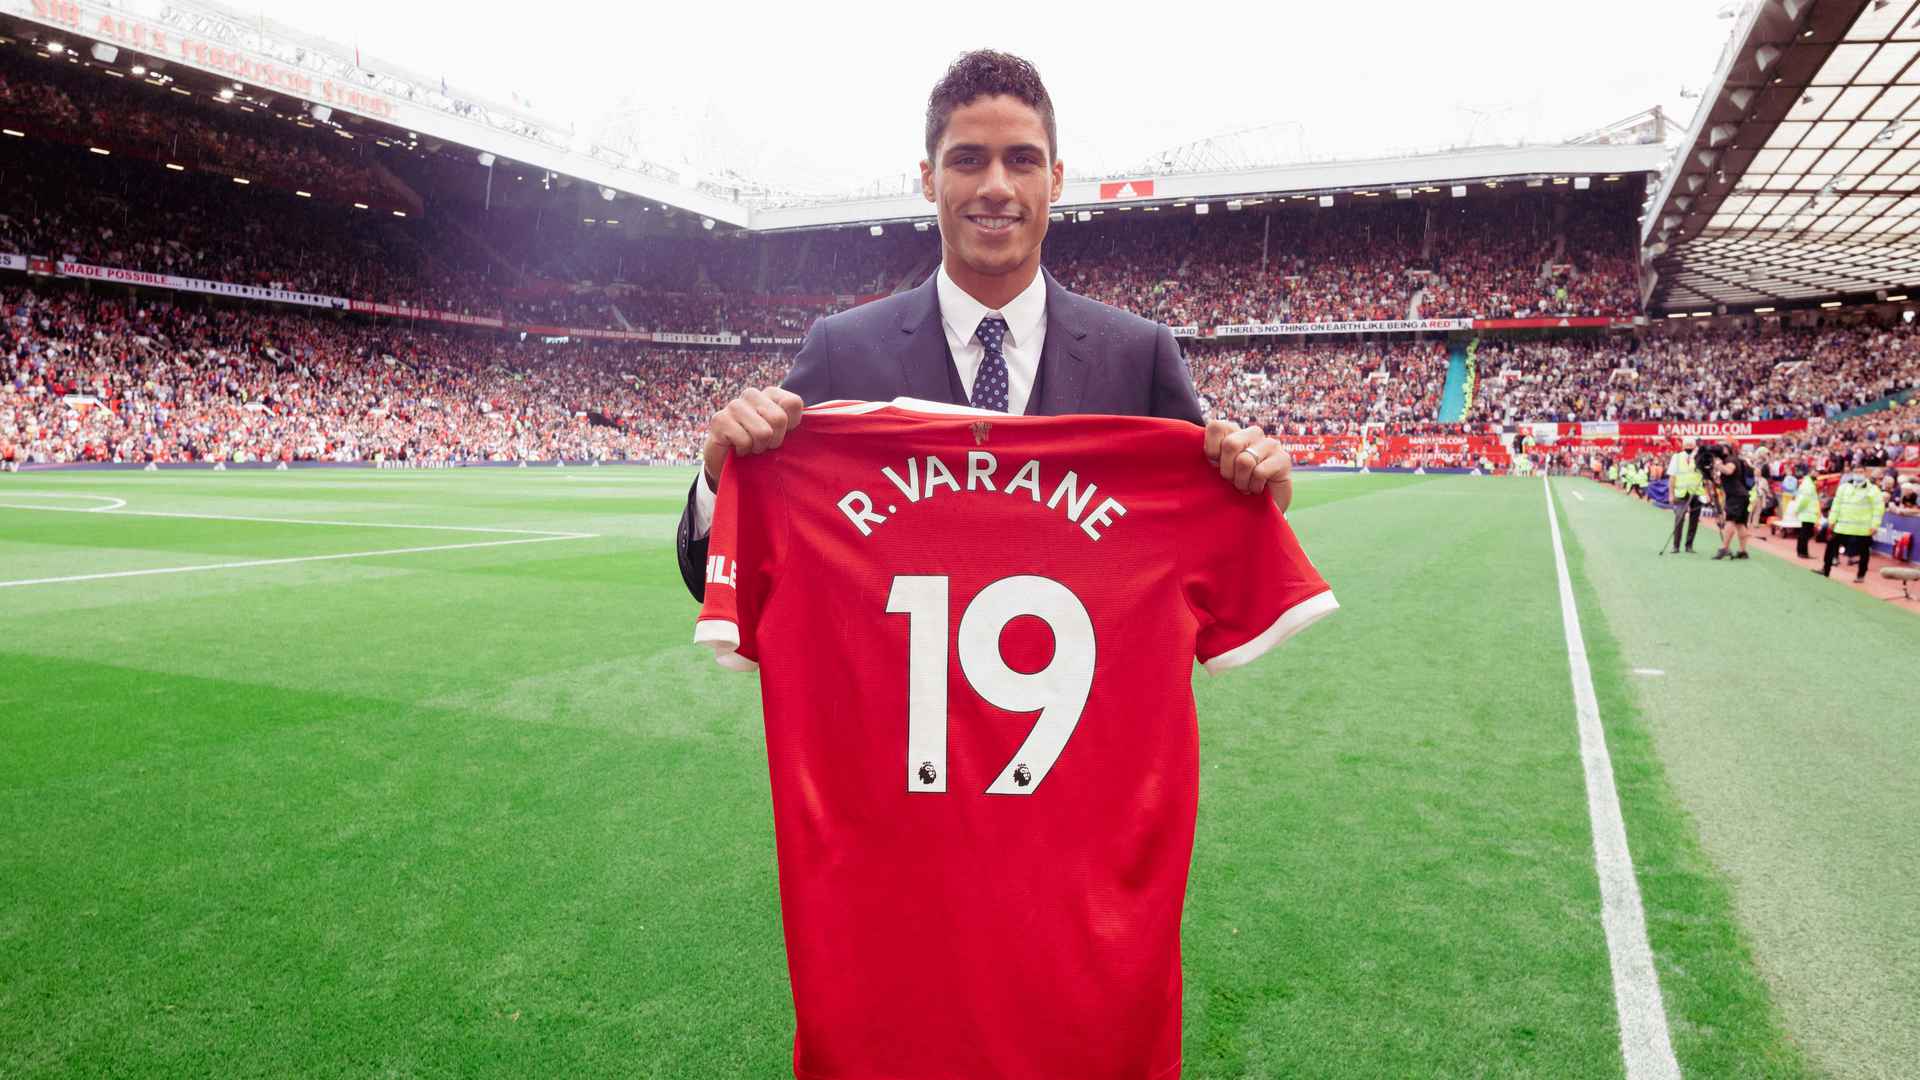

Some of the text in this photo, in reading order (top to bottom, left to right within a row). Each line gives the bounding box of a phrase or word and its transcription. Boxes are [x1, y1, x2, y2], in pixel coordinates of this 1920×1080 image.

[64, 263, 103, 277] MADE
[1174, 328, 1196, 336] SAID
[1265, 324, 1309, 333] NOTHING
[1311, 324, 1325, 332] ON
[1326, 322, 1361, 331] EARTH
[1362, 321, 1385, 330] LIKE
[1387, 320, 1418, 329] BEING
[1421, 320, 1428, 328] A
[1657, 423, 1752, 435] MANUTD.COM
[837, 451, 1127, 541] R.VARANE
[885, 575, 1097, 795] 19
